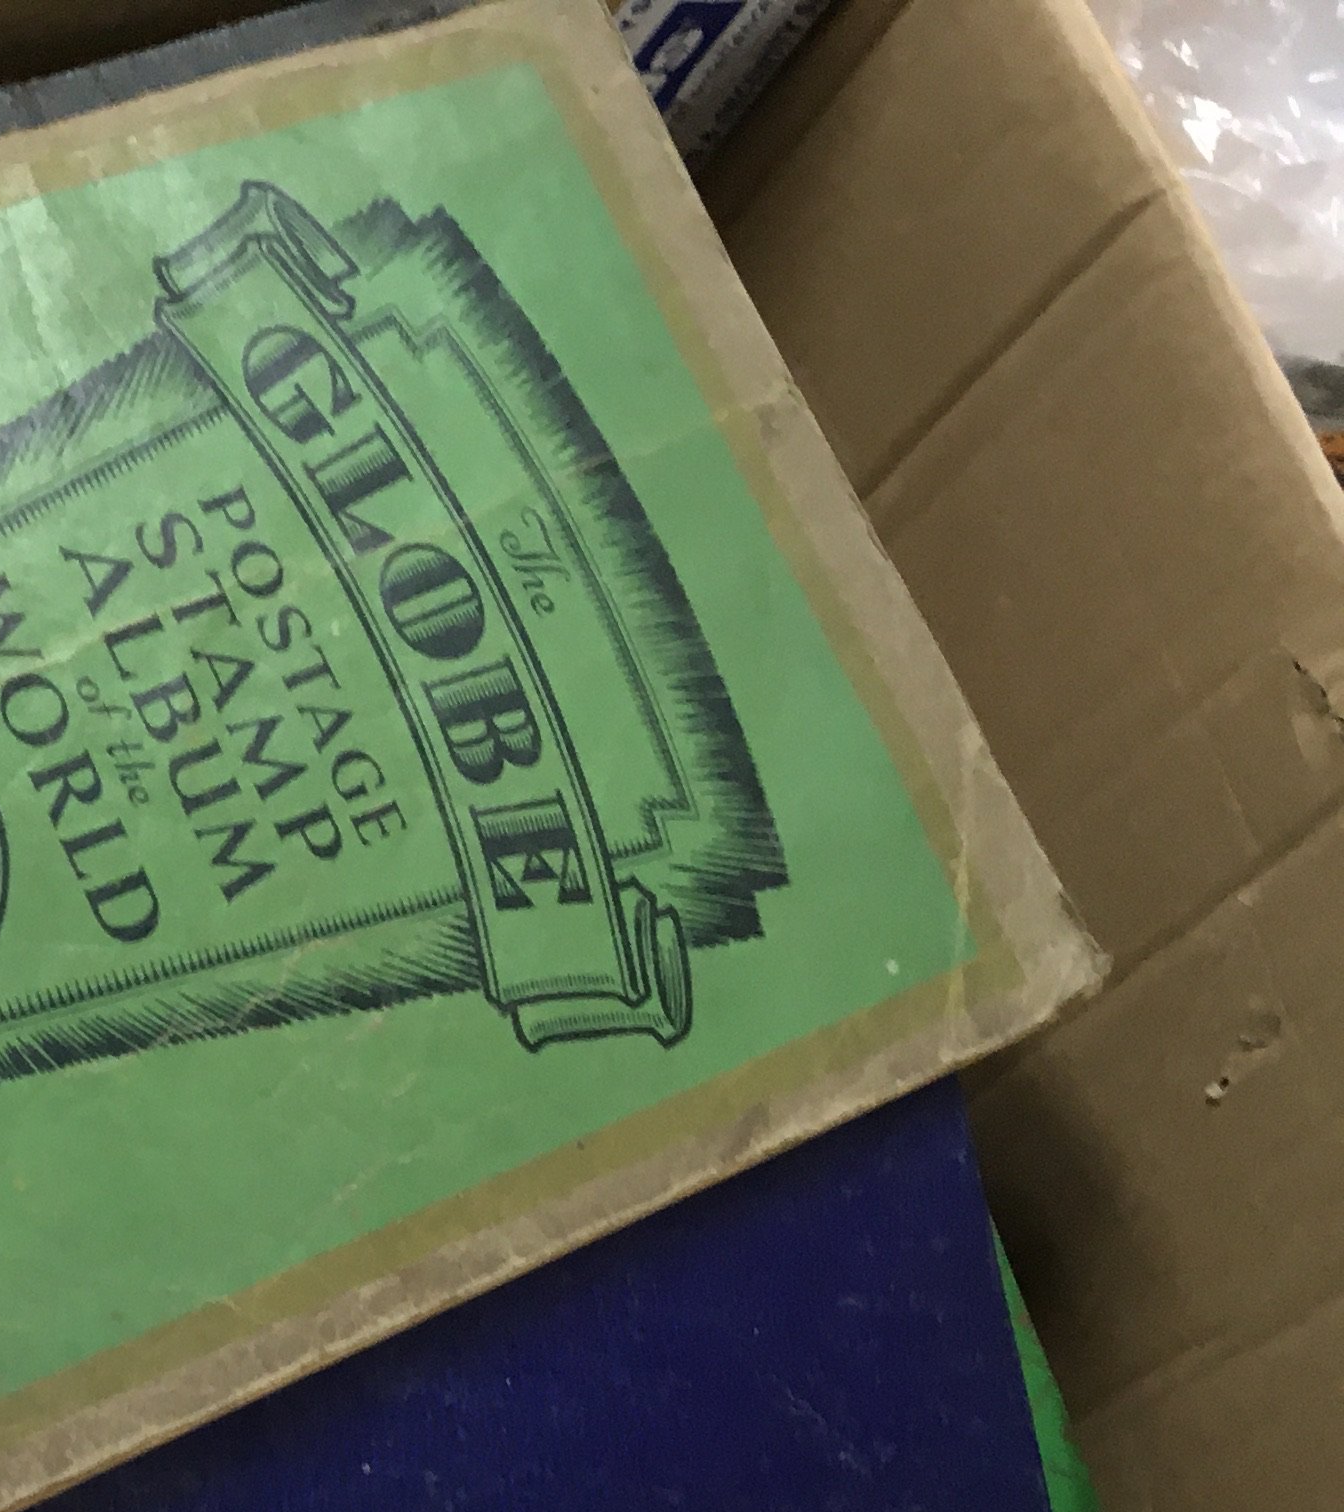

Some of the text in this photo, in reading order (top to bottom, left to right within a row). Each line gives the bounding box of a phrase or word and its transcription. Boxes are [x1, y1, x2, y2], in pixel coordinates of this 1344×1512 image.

[60, 539, 278, 905] ALBUM
[132, 510, 343, 863] STAMP
[198, 483, 407, 845] POSTAGE
[240, 323, 592, 912] GLOBE
[498, 503, 555, 618] The
[76, 672, 152, 808] of the
